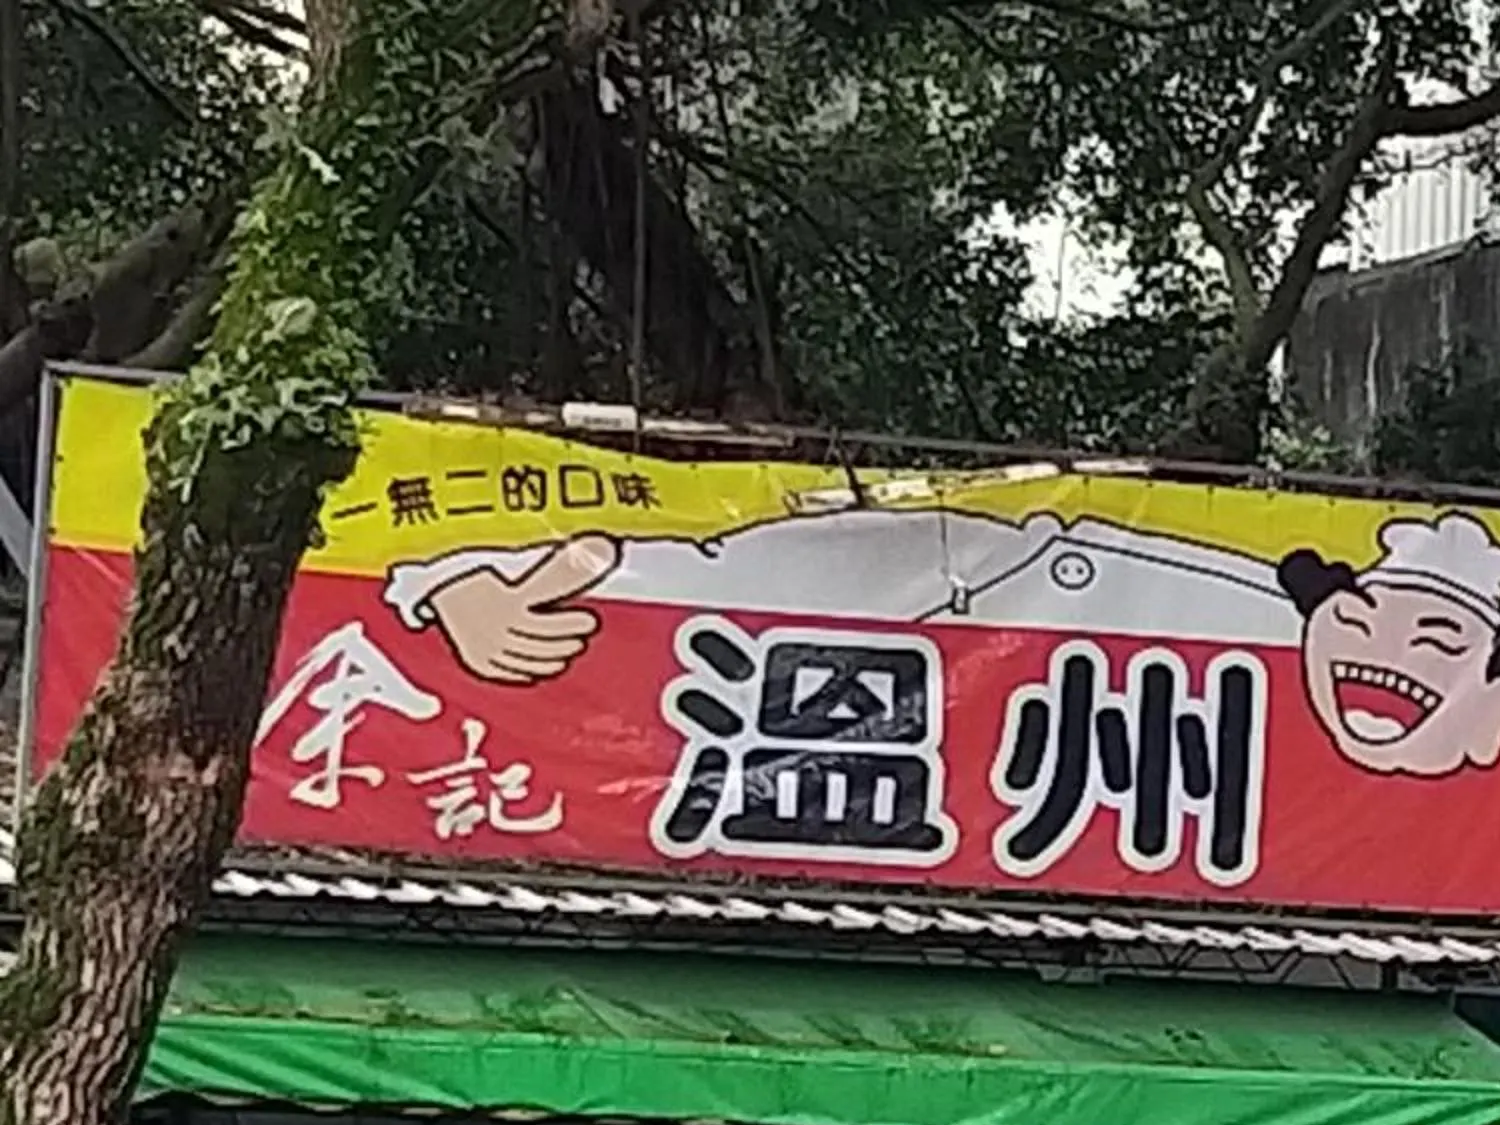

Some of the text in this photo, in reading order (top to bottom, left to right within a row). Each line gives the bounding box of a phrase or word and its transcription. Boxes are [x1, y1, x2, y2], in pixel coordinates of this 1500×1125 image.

[330, 463, 662, 528] 一無二的口味
[650, 615, 1270, 887] 溫州
